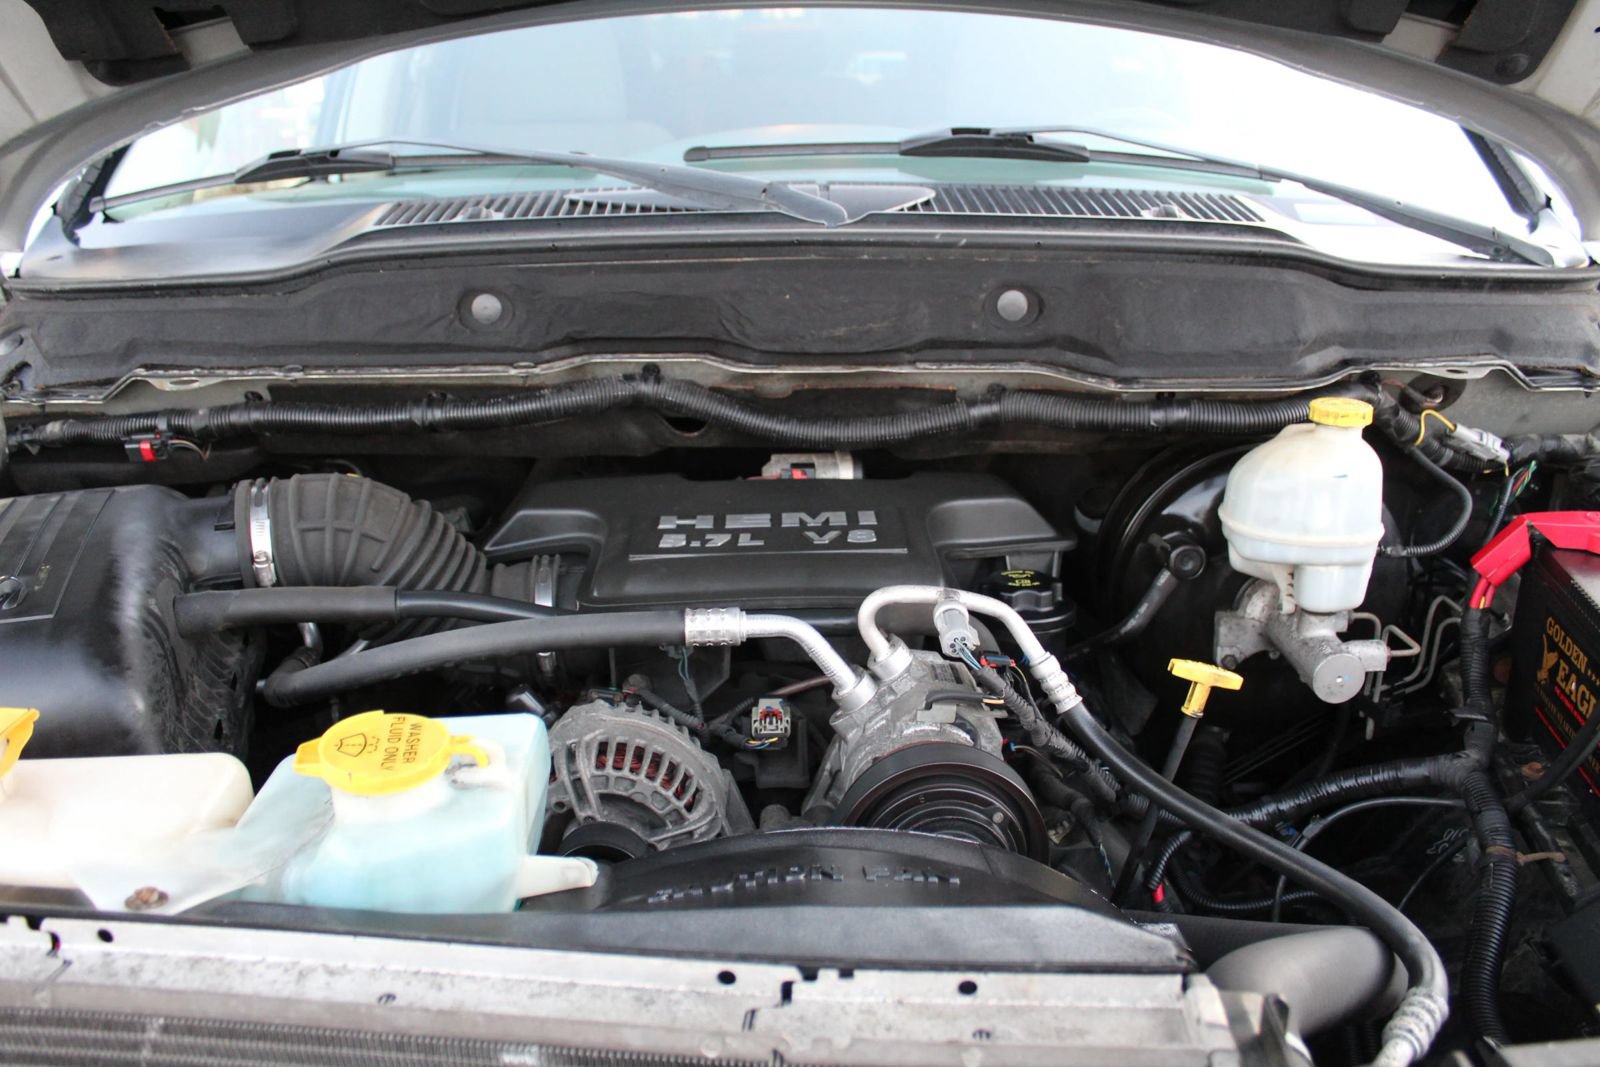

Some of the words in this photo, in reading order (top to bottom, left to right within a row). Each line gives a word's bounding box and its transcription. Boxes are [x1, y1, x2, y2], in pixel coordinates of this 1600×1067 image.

[657, 510, 878, 529] HEMI
[658, 532, 765, 548] 5.7L
[802, 529, 878, 544] V8
[1546, 616, 1588, 673] GOLDEN
[387, 716, 406, 743] FLUID
[403, 722, 423, 763] WASHER
[380, 746, 399, 771] ONLY
